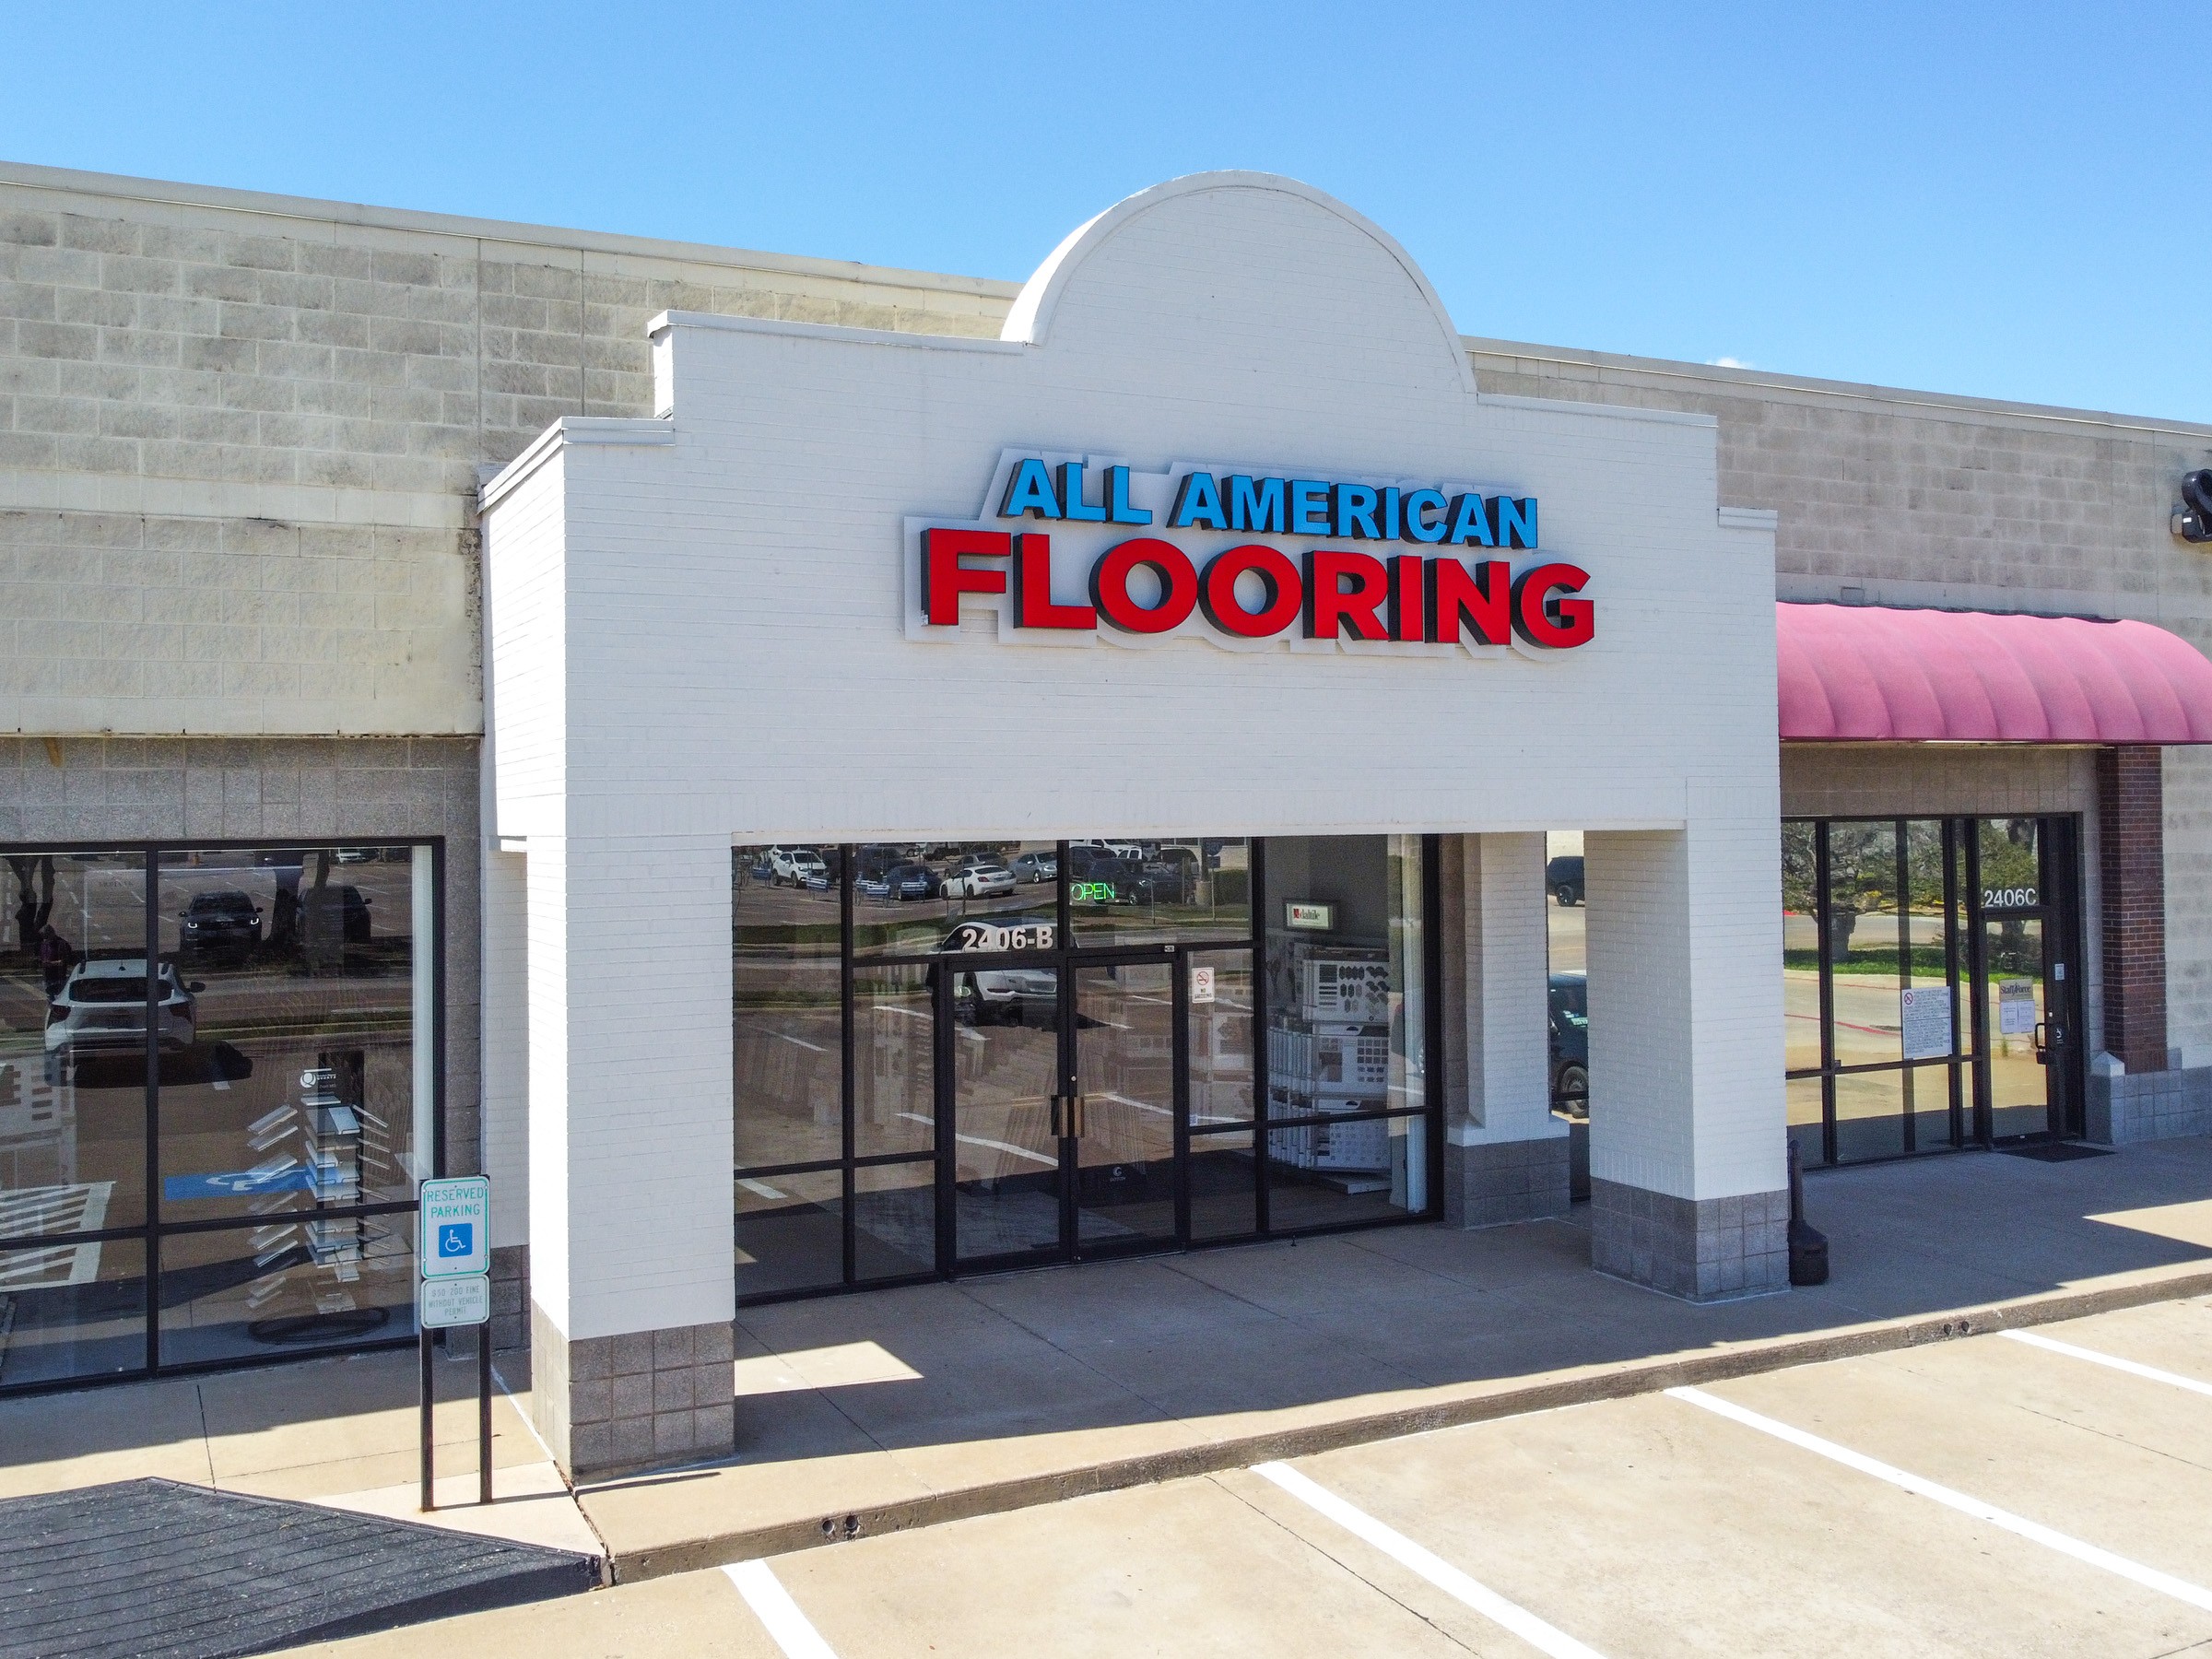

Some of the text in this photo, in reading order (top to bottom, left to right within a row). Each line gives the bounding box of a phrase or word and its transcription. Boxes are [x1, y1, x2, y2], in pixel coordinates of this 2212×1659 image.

[1003, 458, 1538, 549] ALL AMERICAN
[922, 527, 1595, 650] FLOORING
[1071, 882, 1115, 901] OPEN
[1983, 888, 2037, 908] 2406C
[961, 925, 1054, 953] 2406-B
[427, 1187, 484, 1202] RESERVED
[430, 1204, 480, 1218] PARKING
[465, 1285, 480, 1294] FINE
[429, 1295, 484, 1308] WITHOUT VEHICLE
